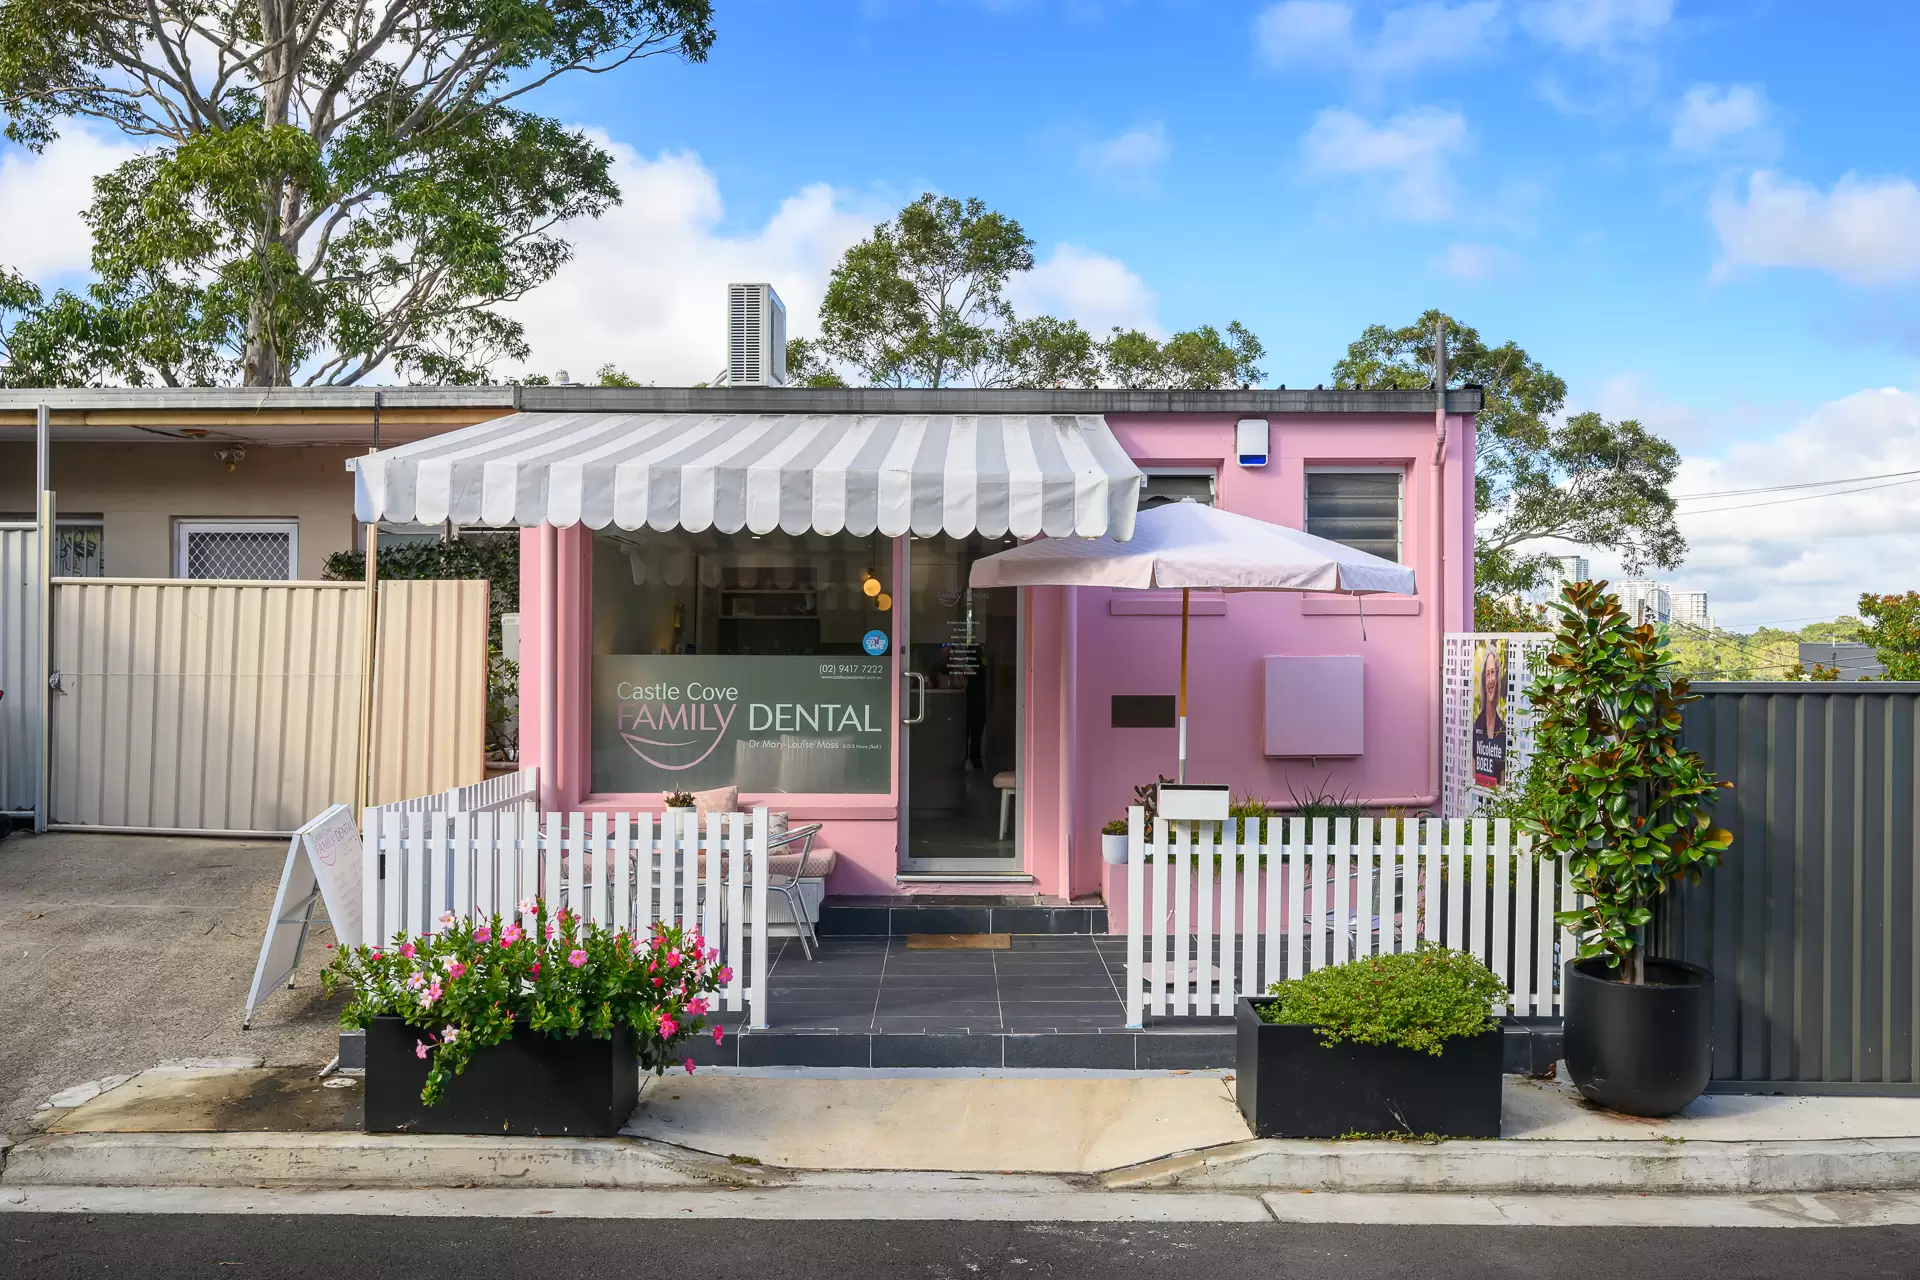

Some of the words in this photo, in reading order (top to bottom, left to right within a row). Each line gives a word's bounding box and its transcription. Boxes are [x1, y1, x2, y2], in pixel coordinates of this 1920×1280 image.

[819, 664, 836, 675] (02)
[838, 664, 859, 673] 9417
[862, 665, 884, 674] 7222
[617, 681, 680, 701] Castle
[686, 682, 739, 701] Cove
[618, 703, 737, 731] FAMILY
[749, 703, 882, 732] DENTAL
[749, 739, 760, 748] Dr
[762, 739, 815, 750] Mary-Louise
[816, 740, 840, 749] Moss
[1476, 740, 1502, 759] Nicolette
[1476, 756, 1493, 773] BOELE
[334, 821, 355, 842] DENTAL
